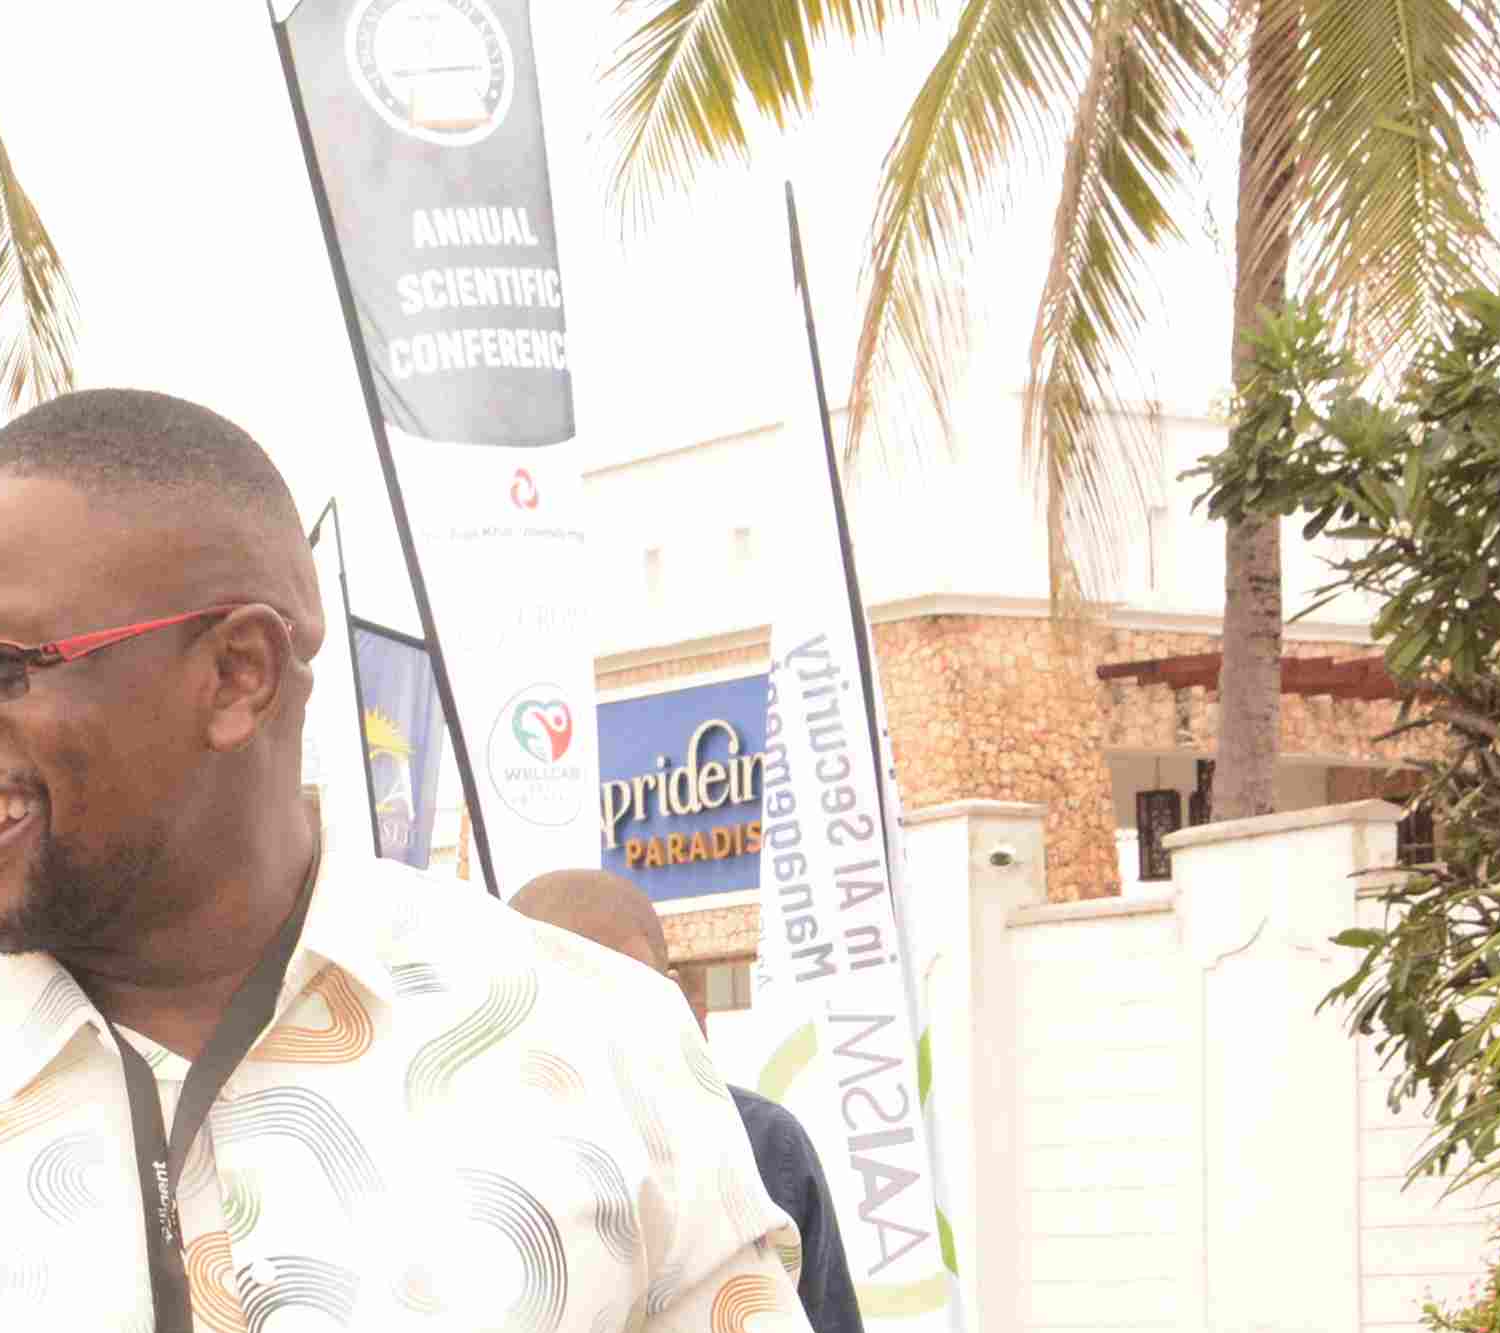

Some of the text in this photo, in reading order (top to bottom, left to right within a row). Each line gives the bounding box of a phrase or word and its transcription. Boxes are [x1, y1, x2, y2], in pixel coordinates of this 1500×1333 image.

[412, 206, 538, 248] ANNUAL
[397, 266, 561, 315] SCIENTIFIC
[389, 328, 565, 378] CONFERENC
[600, 719, 767, 849] pridein
[624, 820, 761, 870] PARADIS
